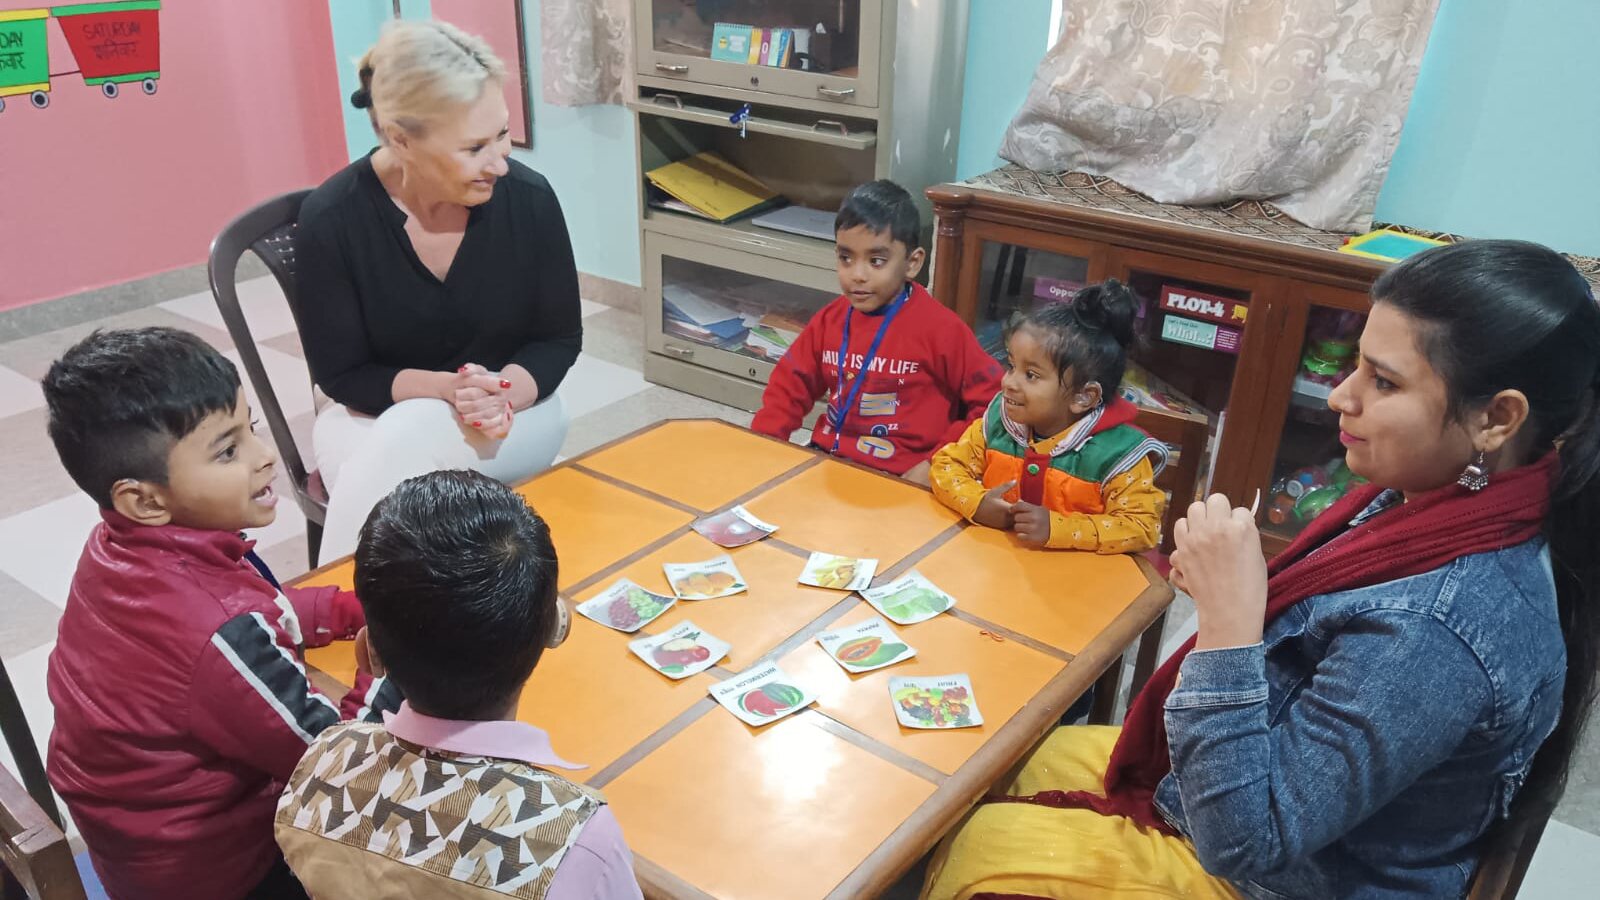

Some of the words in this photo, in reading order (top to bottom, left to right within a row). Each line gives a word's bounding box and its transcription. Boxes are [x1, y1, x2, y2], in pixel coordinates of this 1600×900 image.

[1166, 292, 1225, 318] PLOT-4
[822, 350, 848, 367] MUC
[850, 353, 864, 369] IS
[867, 356, 888, 373] MY
[890, 358, 919, 375] LIFE
[735, 666, 777, 689] WATERMELON
